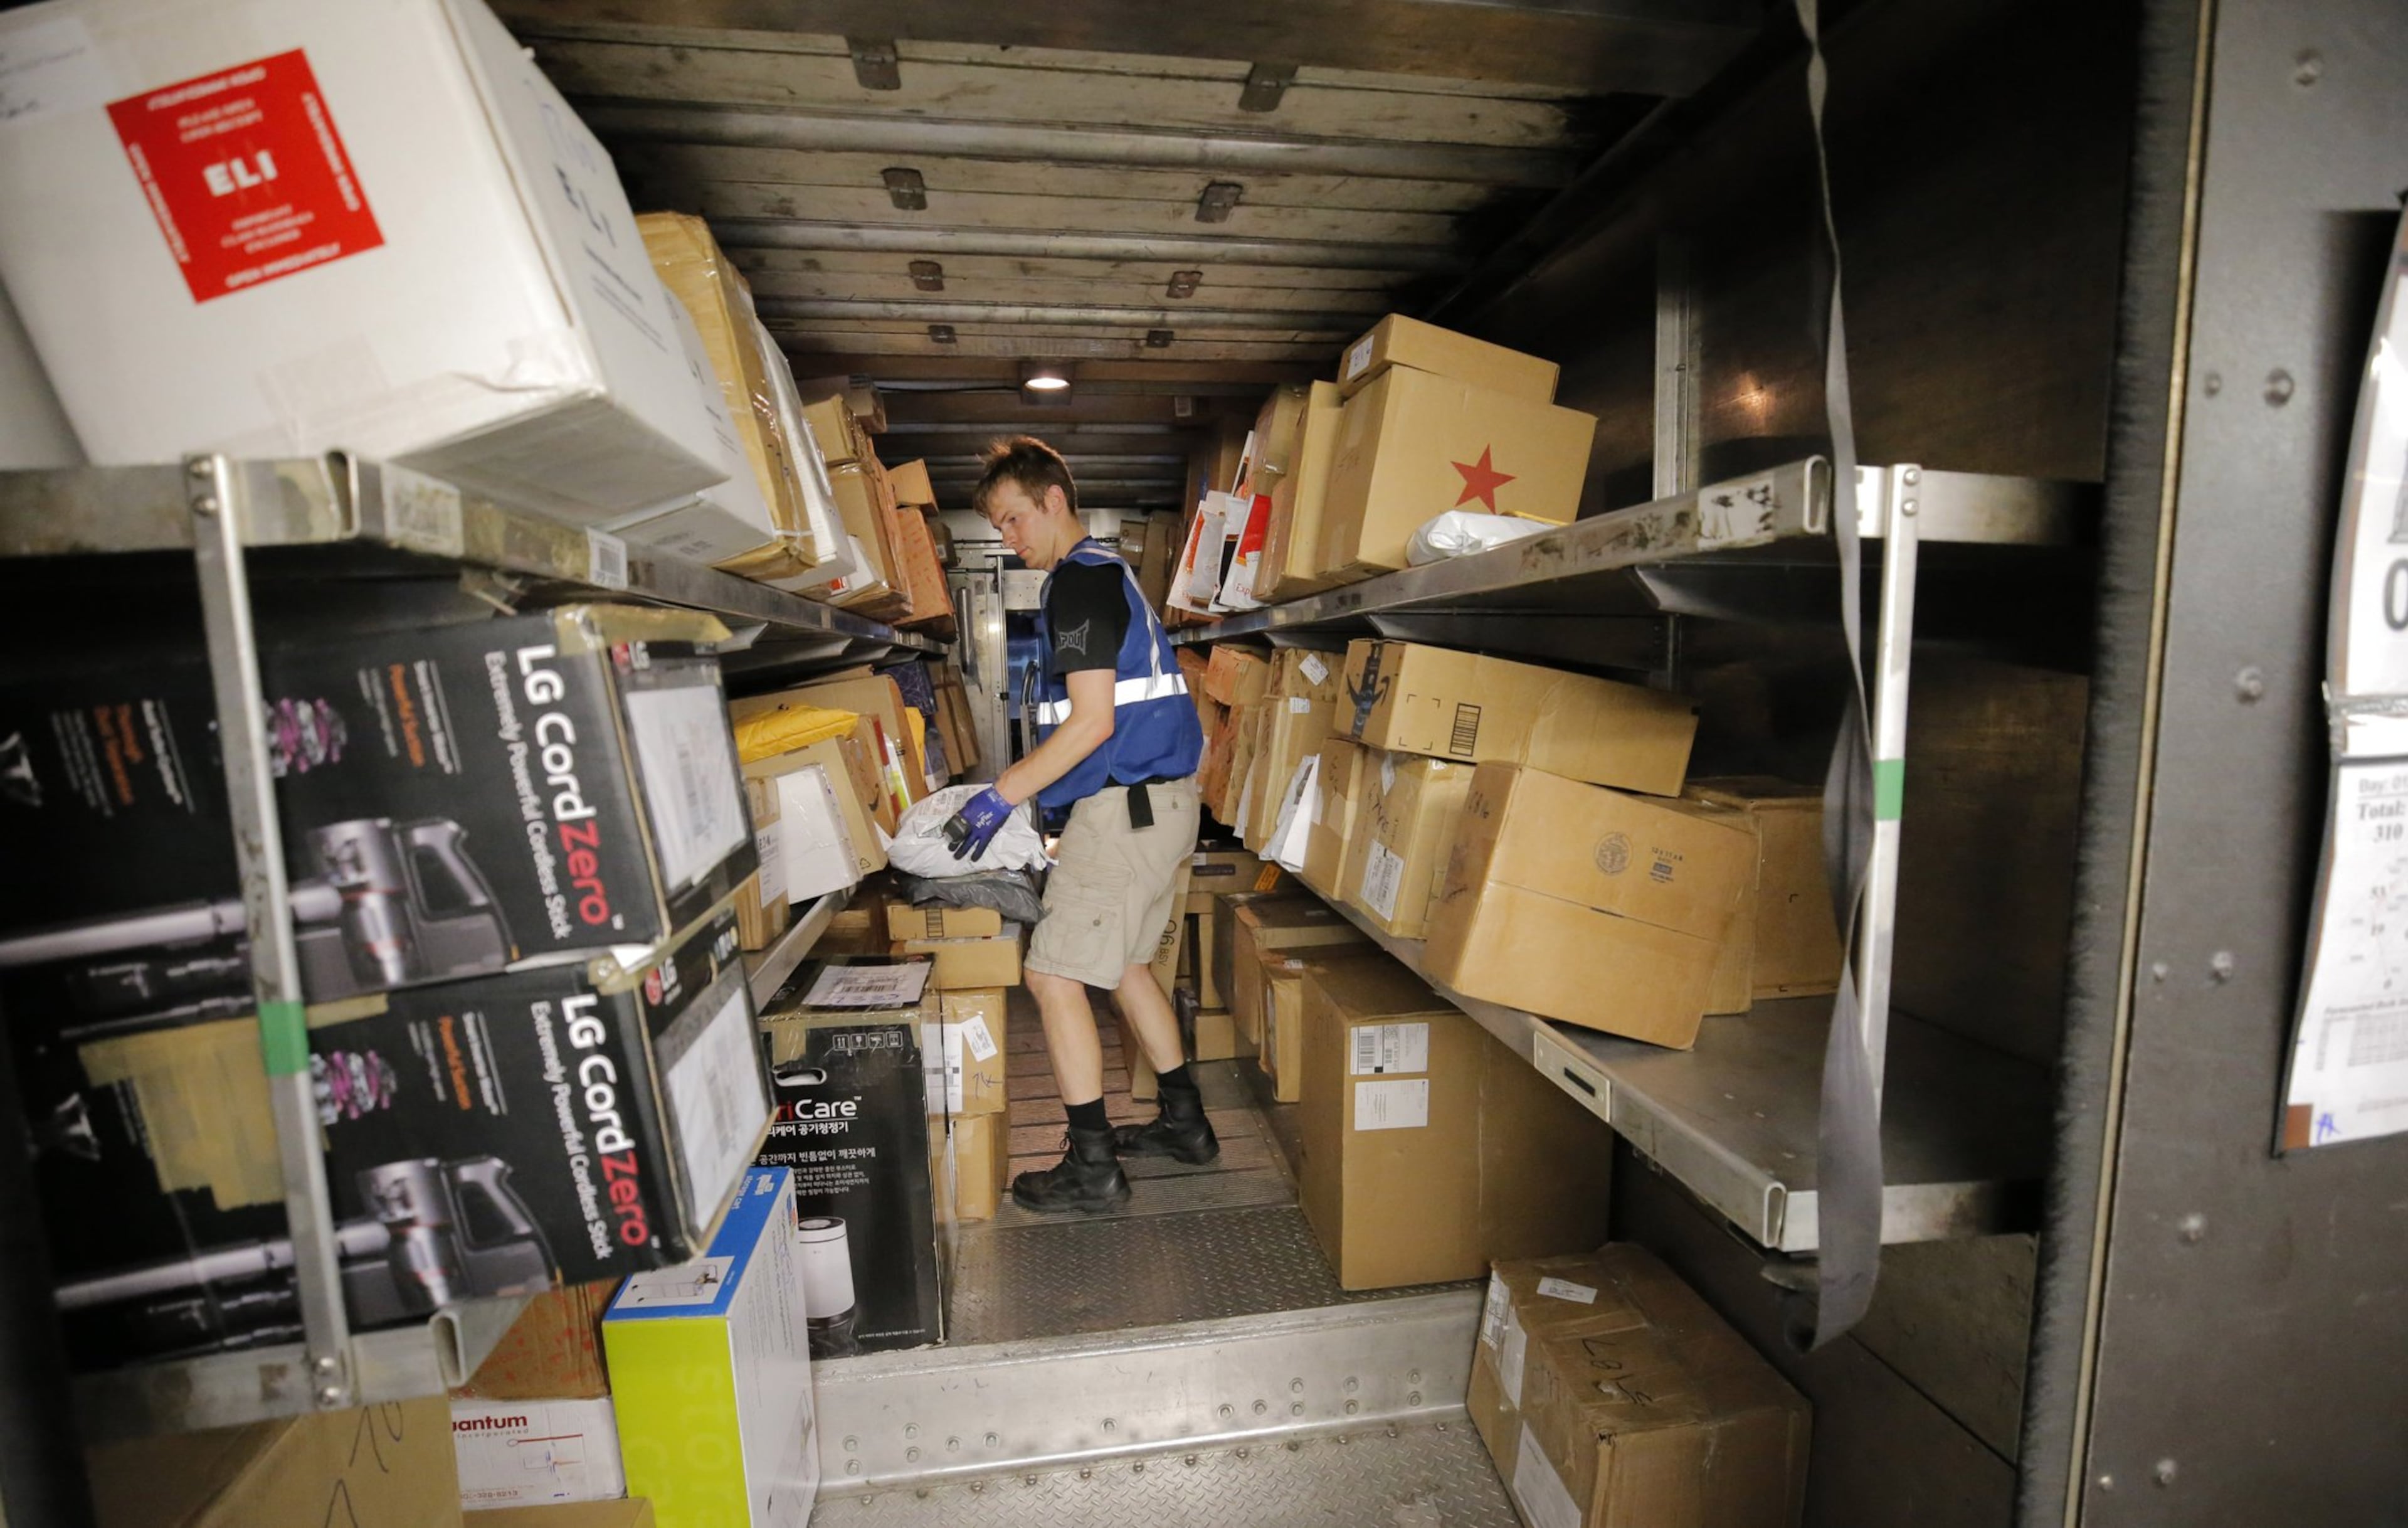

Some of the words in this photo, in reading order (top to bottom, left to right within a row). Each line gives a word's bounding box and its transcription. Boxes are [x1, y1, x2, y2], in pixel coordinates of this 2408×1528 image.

[203, 149, 278, 198] ELI
[518, 644, 564, 706] LG
[485, 650, 522, 741] Extremely
[509, 742, 541, 820] Powerful
[528, 820, 557, 894] Cordless
[546, 896, 572, 939] Stick
[2357, 800, 2405, 820] Total:
[2374, 823, 2404, 843] 310
[563, 994, 606, 1048] LG
[531, 1001, 566, 1081] Extremely
[552, 1084, 584, 1155] Powerful
[570, 1155, 600, 1221] Cordless
[588, 1221, 613, 1260] Stick
[798, 1122, 848, 1136] 공기청정기
[759, 1152, 796, 1165] 공간까지
[800, 1150, 836, 1162] 빈틈없이
[838, 1147, 876, 1159] 깨끗하게
